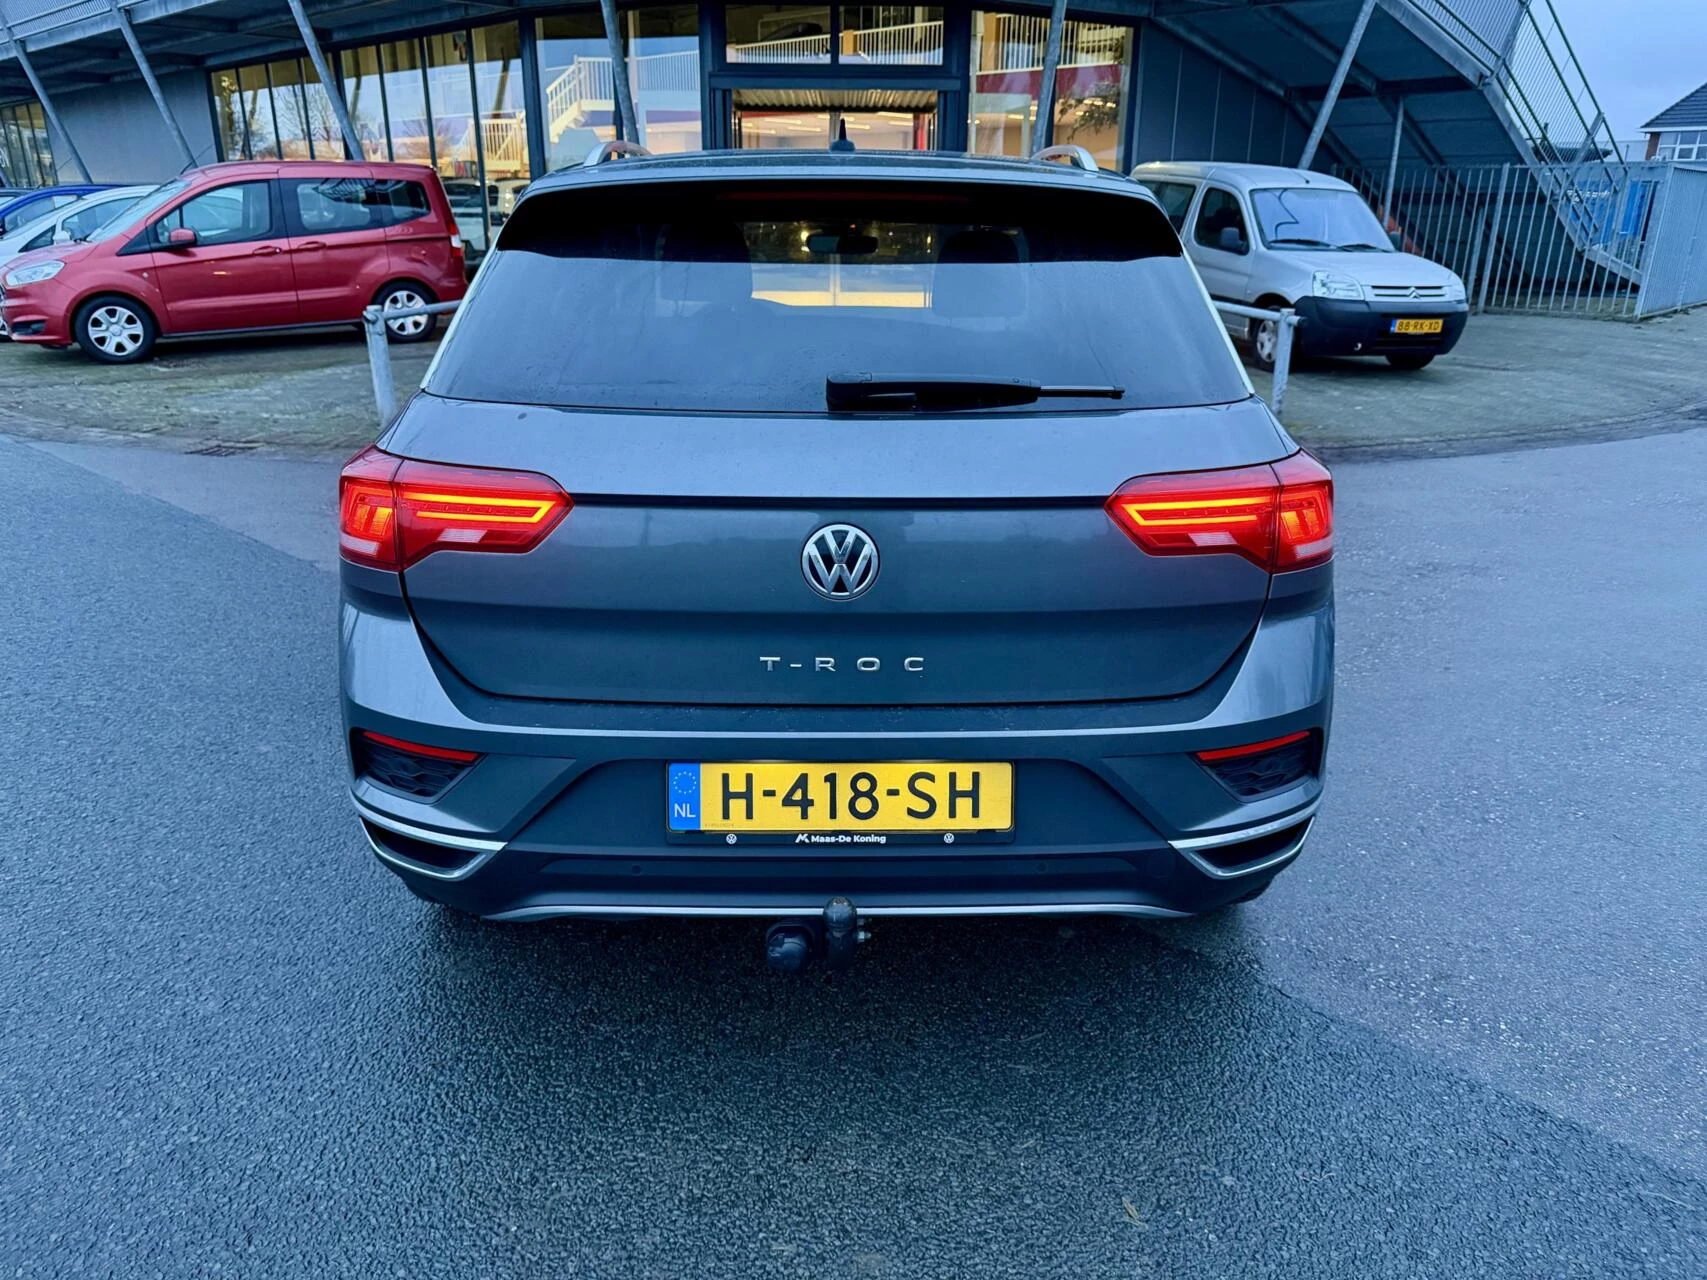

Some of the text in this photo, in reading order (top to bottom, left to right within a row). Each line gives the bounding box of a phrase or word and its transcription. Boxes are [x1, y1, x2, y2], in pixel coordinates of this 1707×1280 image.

[721, 771, 981, 821] H-418-SH
[673, 803, 697, 818] NL
[810, 835, 852, 843] Maas-De
[853, 834, 887, 844] Koning
